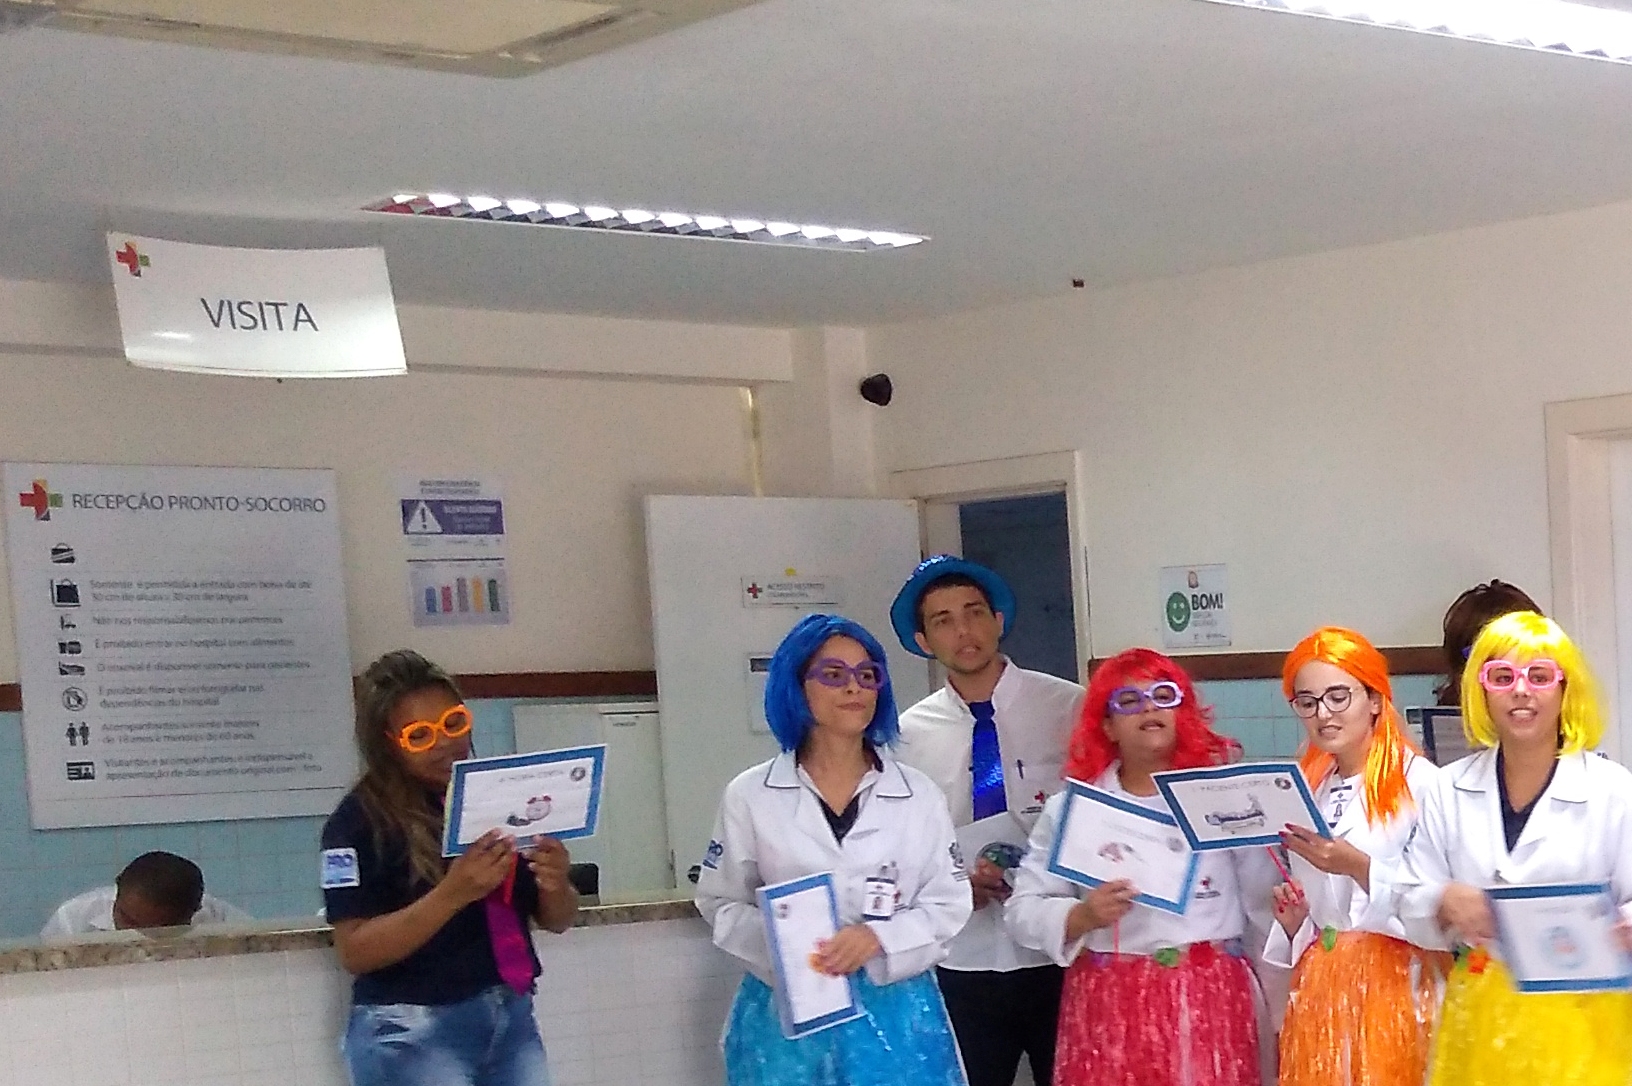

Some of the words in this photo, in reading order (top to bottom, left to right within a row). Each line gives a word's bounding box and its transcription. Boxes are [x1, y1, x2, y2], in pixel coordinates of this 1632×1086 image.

[200, 298, 319, 332] VISITA
[72, 492, 164, 513] RECEPÇÃO
[168, 495, 327, 513] PRONTO-SOCORRO
[1191, 592, 1223, 611] BOM!
